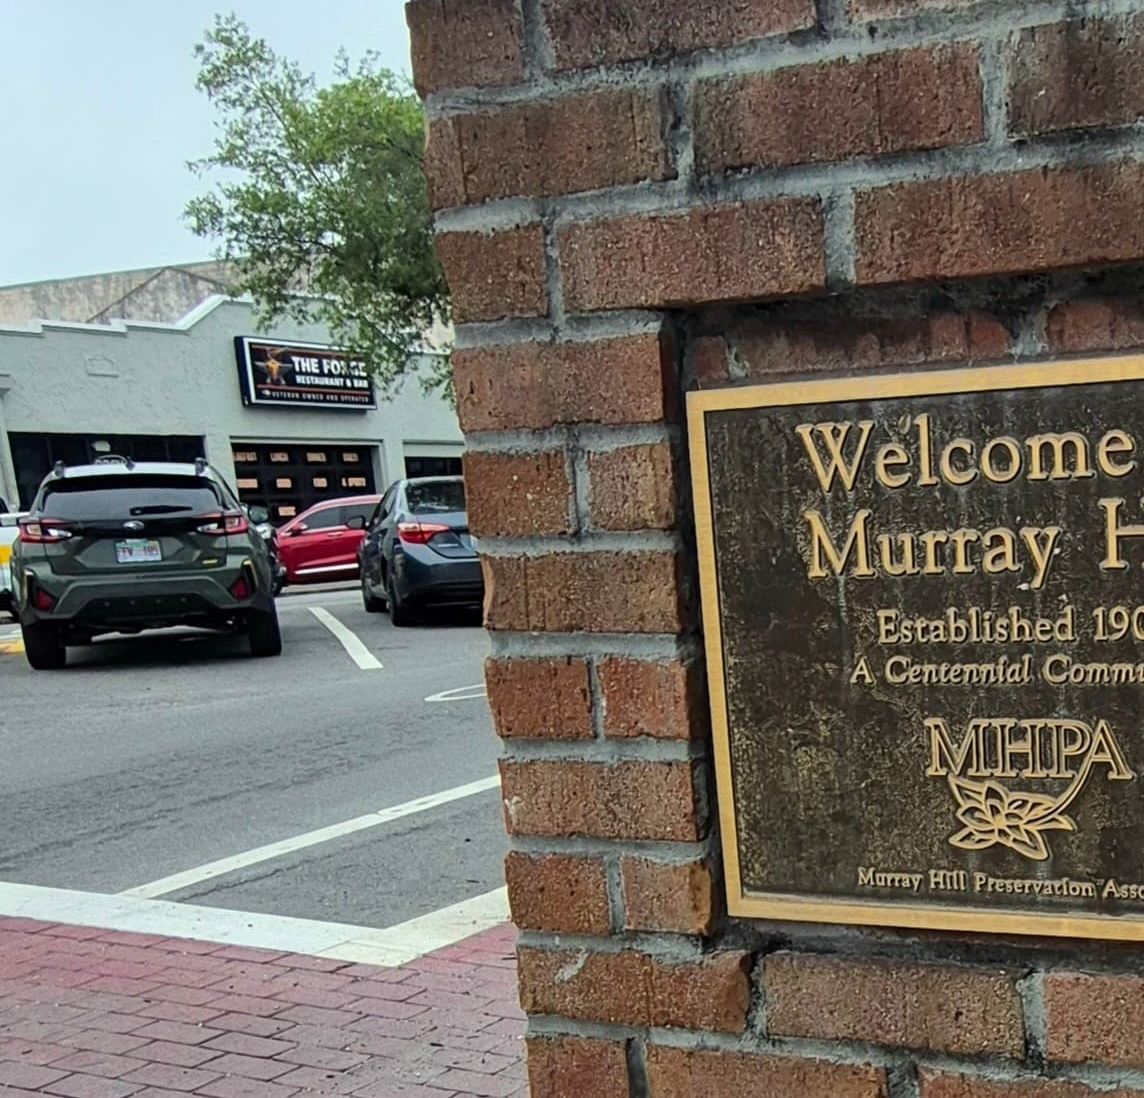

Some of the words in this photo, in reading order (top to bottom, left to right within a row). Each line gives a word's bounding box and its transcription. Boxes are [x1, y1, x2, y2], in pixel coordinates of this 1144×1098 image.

[291, 356, 319, 374] THE
[272, 391, 300, 399] VETERAN
[295, 375, 344, 387] RESTAURANT
[353, 379, 369, 388] BAR
[796, 414, 1136, 492] Welcome
[803, 508, 1061, 590] Murray
[877, 605, 1076, 644] Established
[850, 656, 874, 685] A
[885, 653, 1033, 685] Centennial
[923, 718, 1136, 781] MHPA
[858, 867, 923, 892] Murray
[930, 870, 968, 892] Hill
[974, 872, 1096, 898] Preservation
